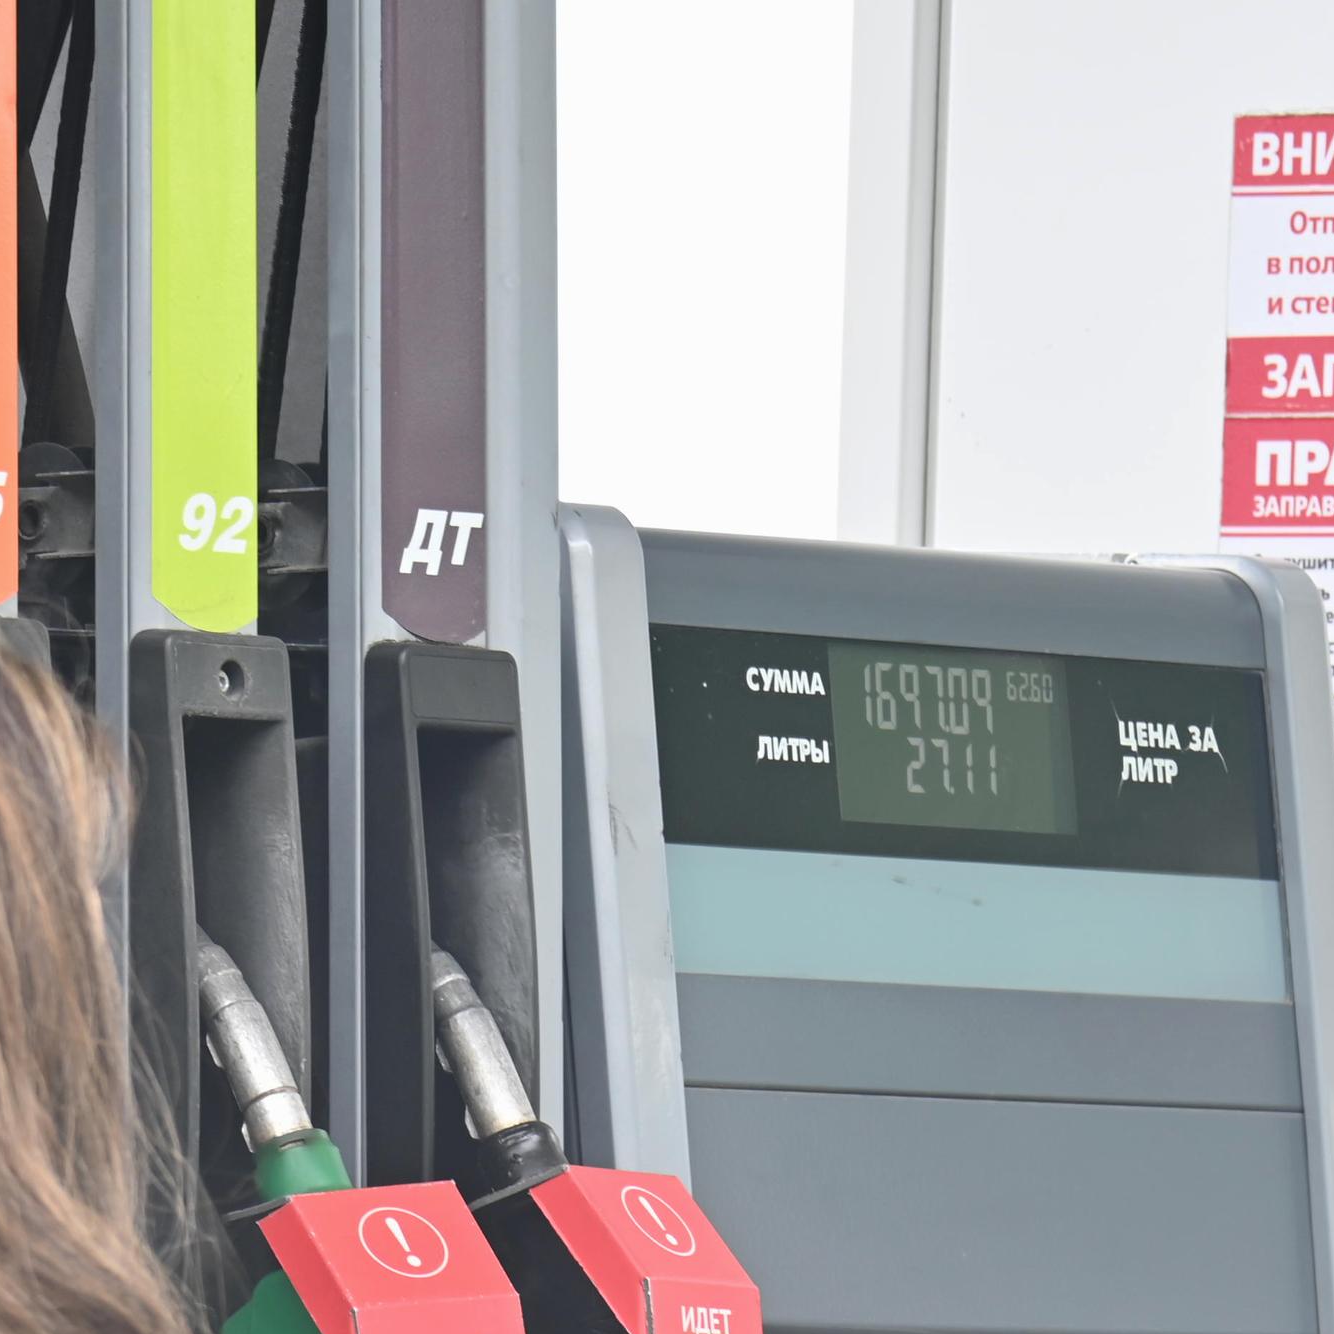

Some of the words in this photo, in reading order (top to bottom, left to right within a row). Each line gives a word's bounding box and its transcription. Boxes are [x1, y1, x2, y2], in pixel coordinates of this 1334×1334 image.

[1267, 256, 1281, 274] в
[1267, 296, 1282, 314] и
[178, 493, 255, 555] 92
[399, 508, 485, 576] ДТ
[745, 667, 826, 696] СУММА
[757, 735, 831, 764] ЛИТРЫ
[1118, 720, 1181, 751] ЦЕНА
[1188, 724, 1221, 754] ЗА
[1121, 756, 1179, 784] ЛИТР
